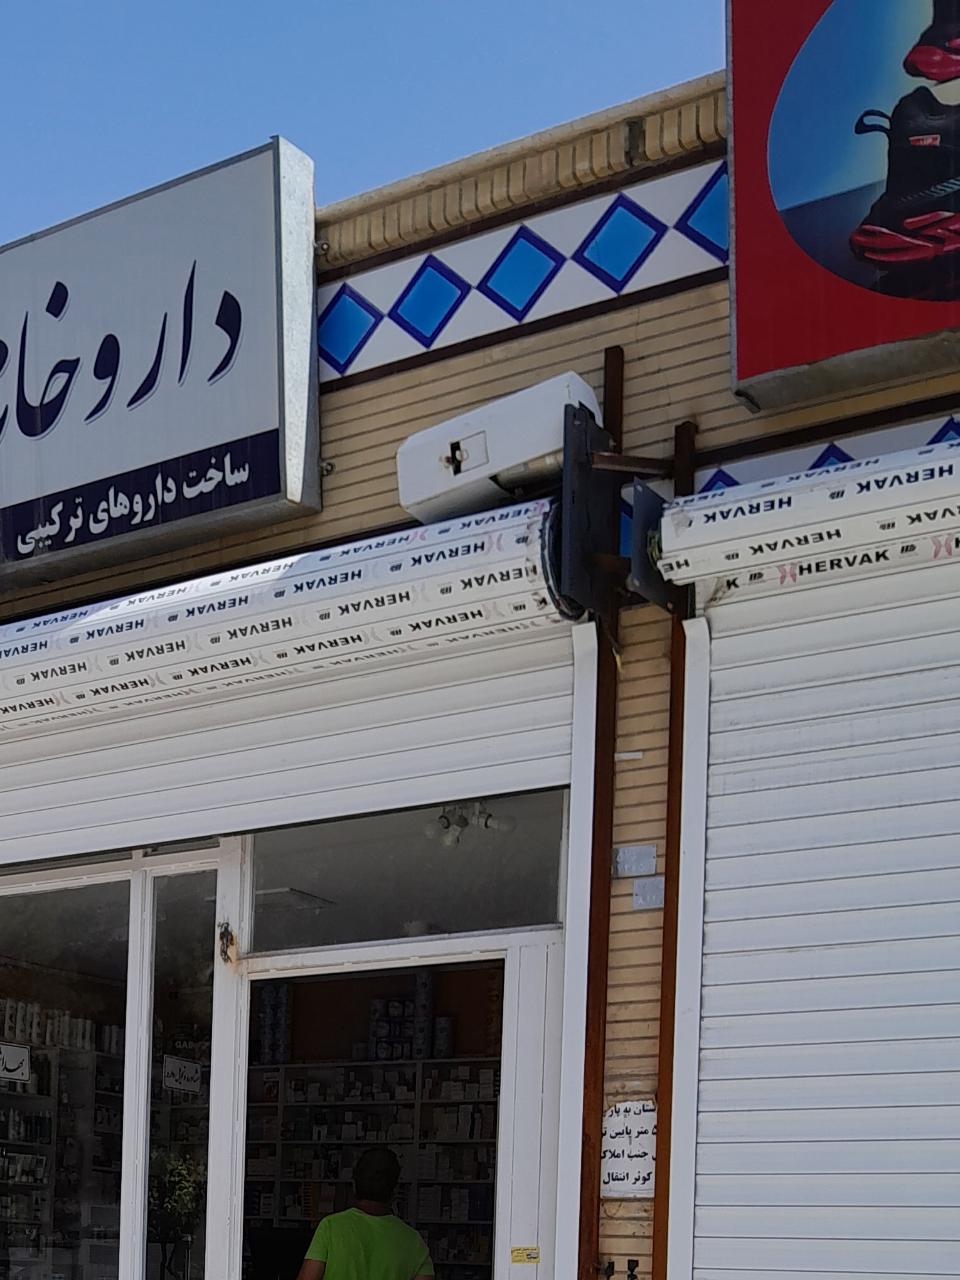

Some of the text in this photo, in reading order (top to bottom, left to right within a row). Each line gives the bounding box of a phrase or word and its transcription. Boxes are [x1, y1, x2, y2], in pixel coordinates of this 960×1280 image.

[17, 453, 250, 555] ساخت داروهای ترکیبی
[704, 464, 954, 524] HERVAK HERVAK
[340, 535, 410, 557] HERVAK
[749, 529, 841, 555] HERVAK
[799, 550, 890, 575] HERVAK
[86, 618, 144, 641] HERVAK
[185, 595, 249, 618] HERVAK
[292, 569, 362, 594] HERVAK
[410, 541, 485, 567] HERVAK
[0, 696, 55, 715] HERVAK
[90, 677, 150, 697] HERVAK
[187, 656, 253, 678] HERVAK
[294, 633, 363, 655] HERVAK
[407, 609, 484, 632] HERVAK
[30, 662, 88, 682] HERVAK
[125, 640, 186, 662] HERVAK
[227, 616, 293, 641] HERVAK
[338, 591, 411, 616] HERVAK
[602, 1171, 629, 1185] انتقال
